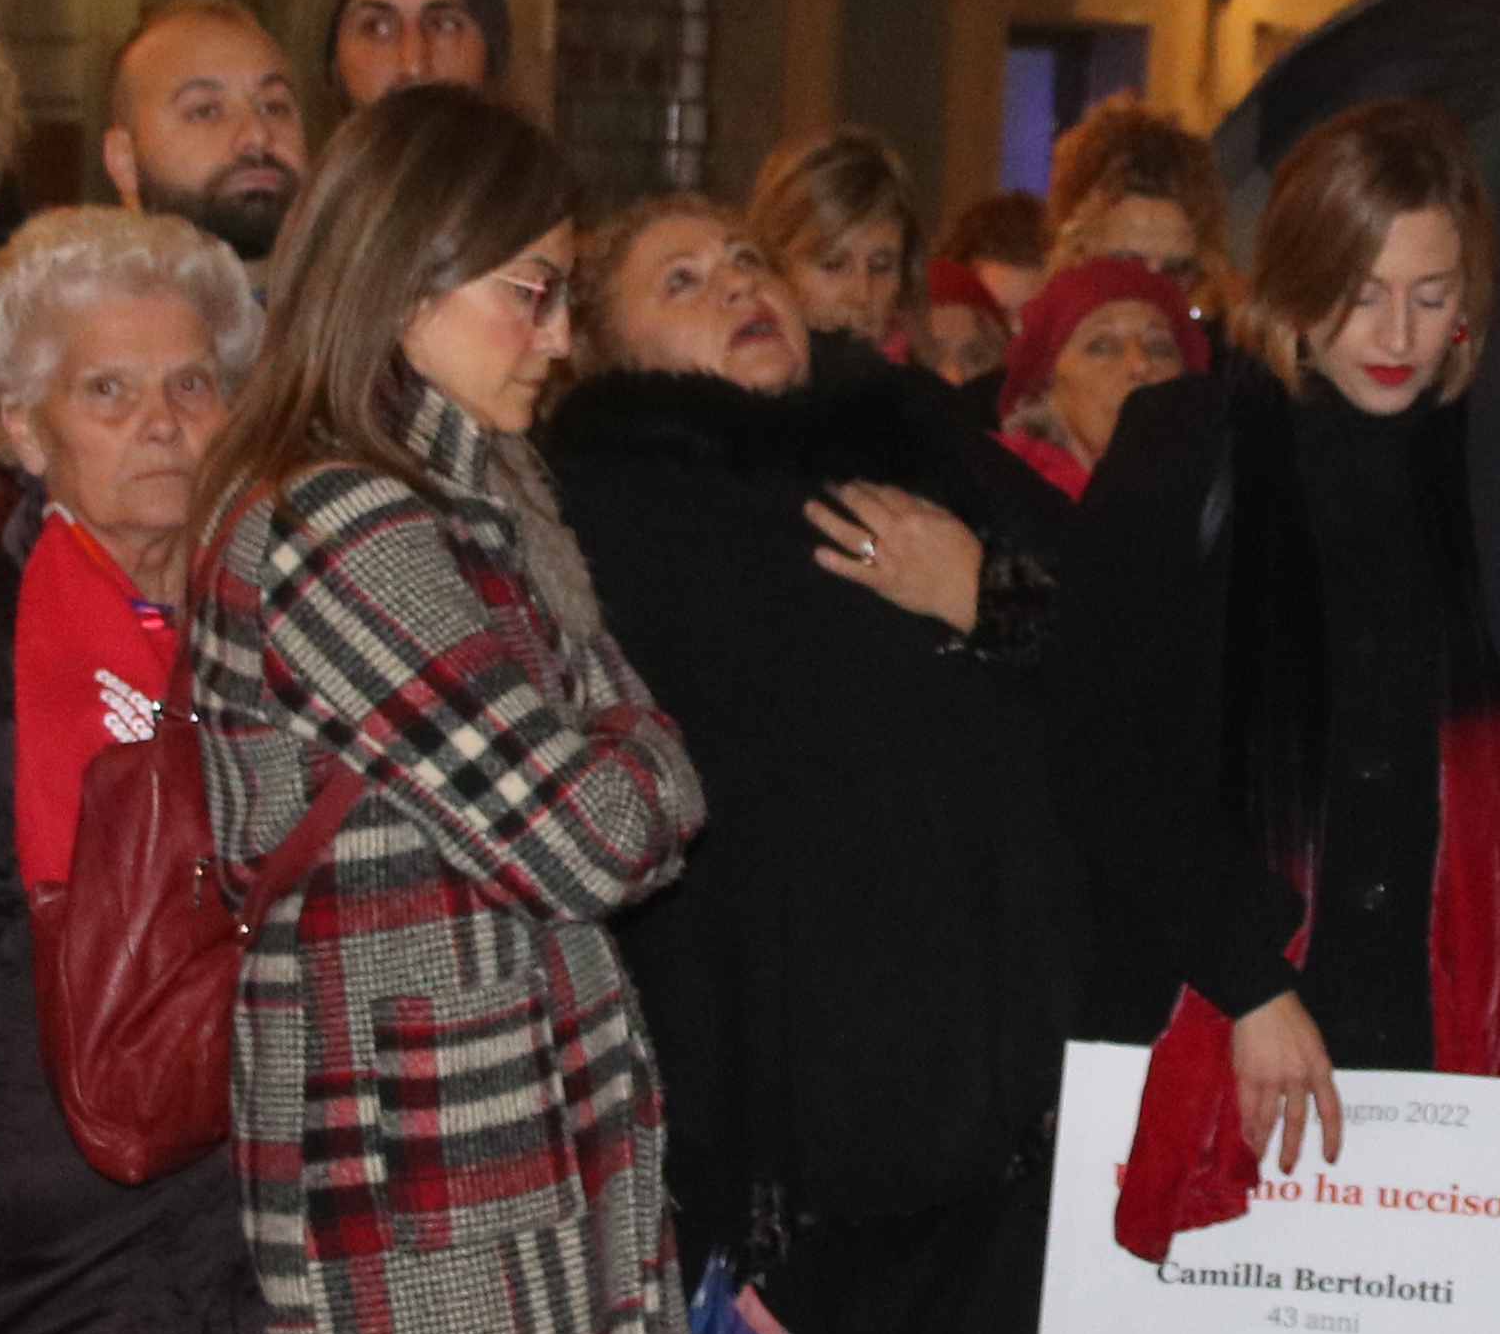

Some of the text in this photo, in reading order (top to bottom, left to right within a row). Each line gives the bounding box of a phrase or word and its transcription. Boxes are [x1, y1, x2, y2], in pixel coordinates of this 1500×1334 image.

[1404, 1101, 1470, 1128] 2022
[1314, 1172, 1363, 1207] ha
[1156, 1260, 1454, 1306] Camilla Bertolotti
[1266, 1306, 1361, 1334] 43 anni
